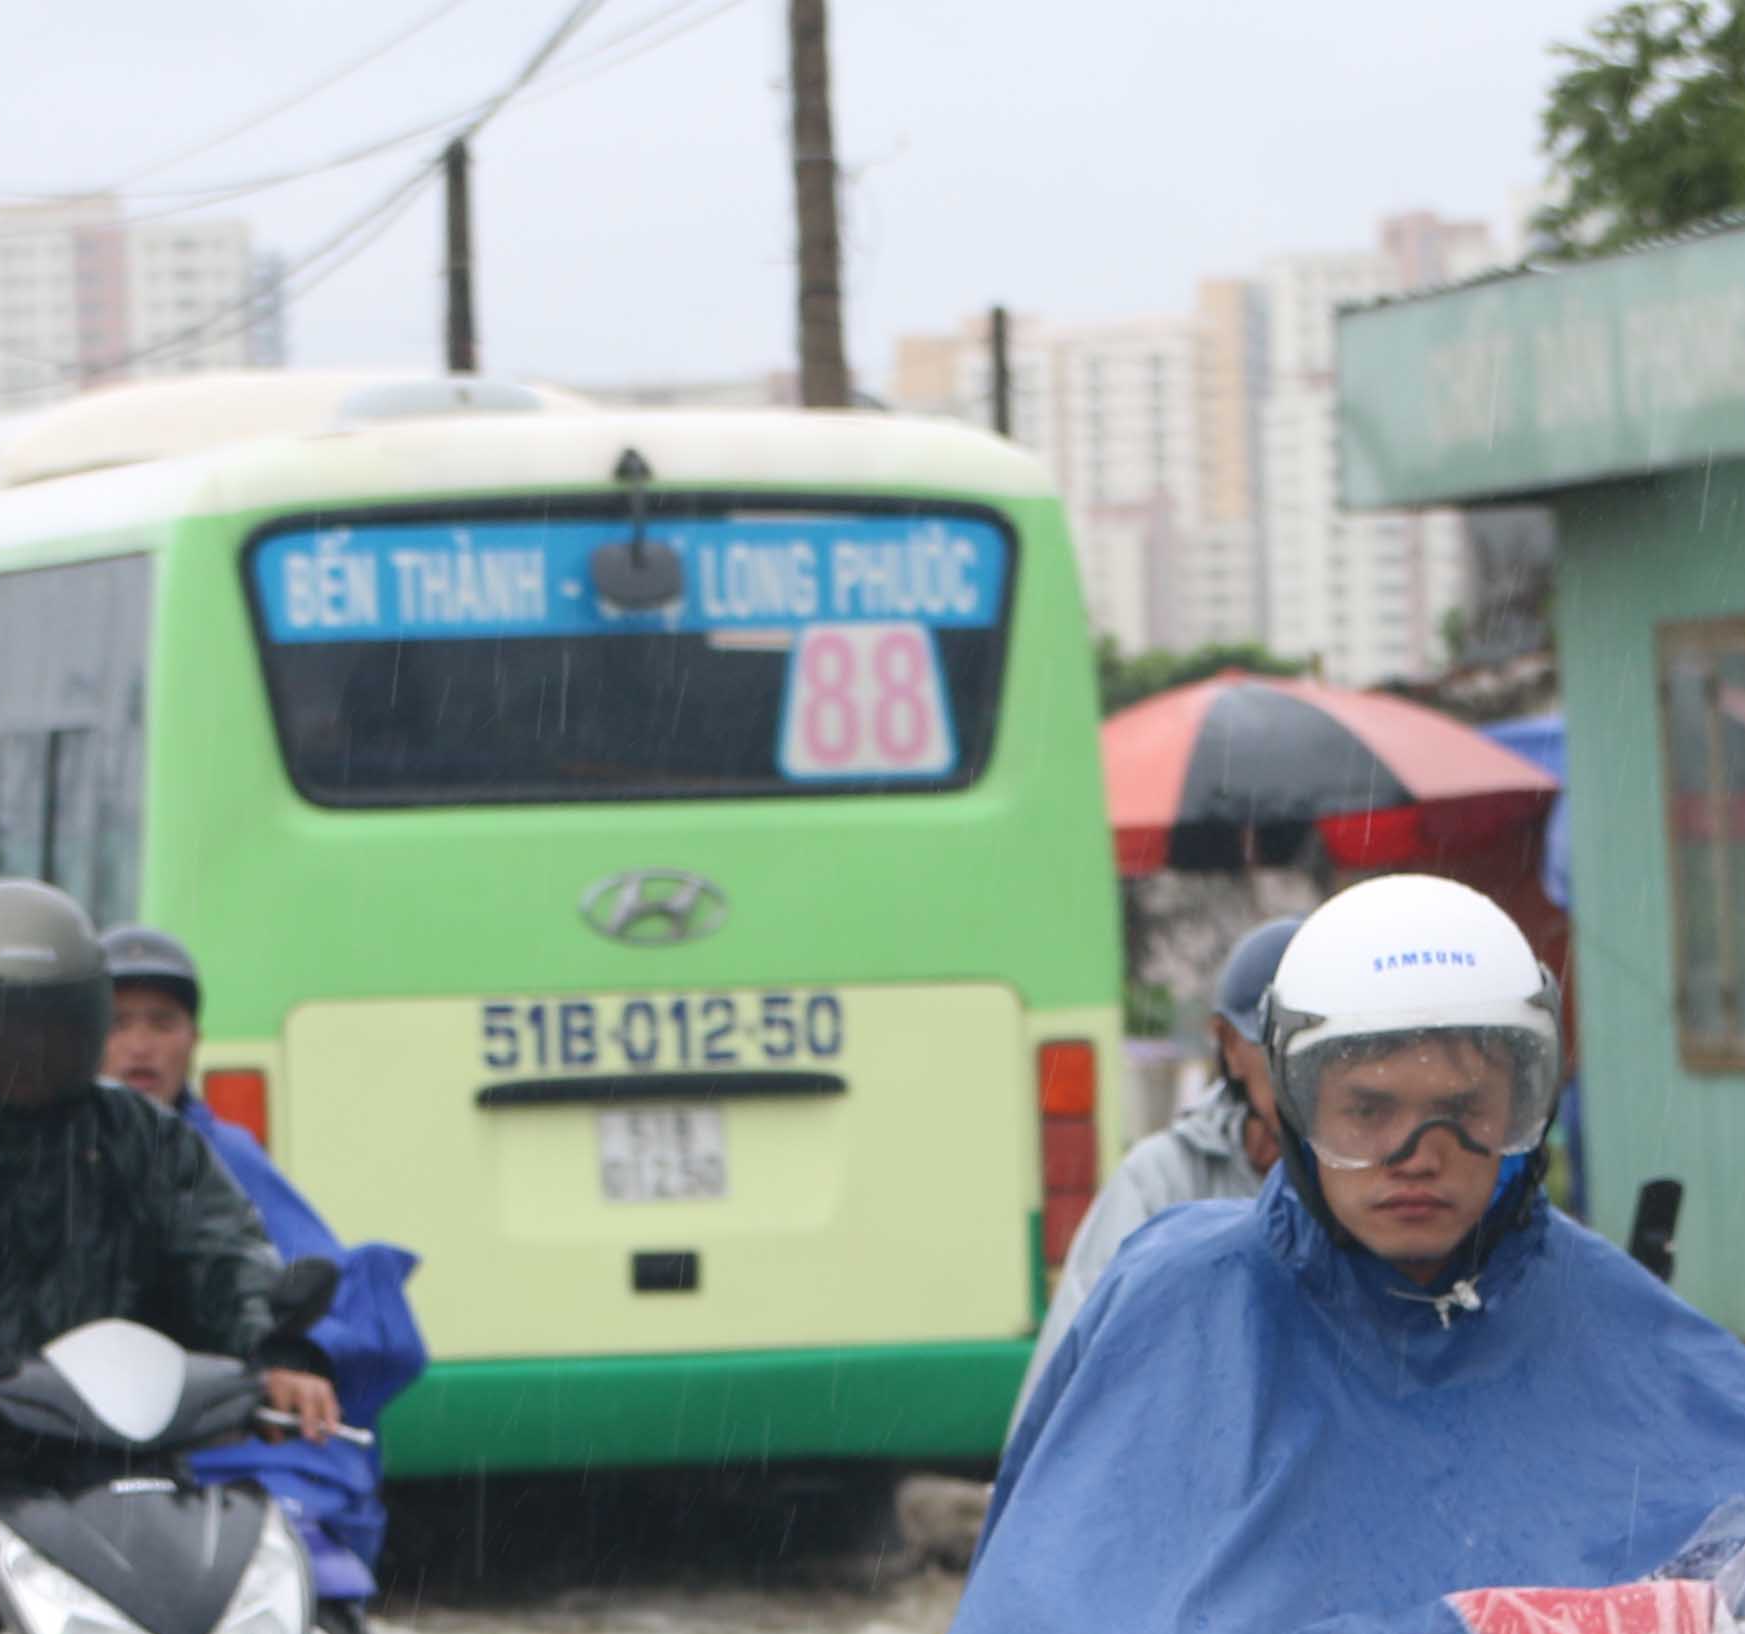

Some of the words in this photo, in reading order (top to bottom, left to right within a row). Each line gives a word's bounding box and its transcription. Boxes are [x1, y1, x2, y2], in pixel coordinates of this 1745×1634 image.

[284, 525, 378, 627] BẾN
[389, 527, 546, 622] THÀNH
[699, 540, 817, 617] LONG
[798, 630, 935, 767] 88
[1373, 950, 1476, 973] SAMSUNG
